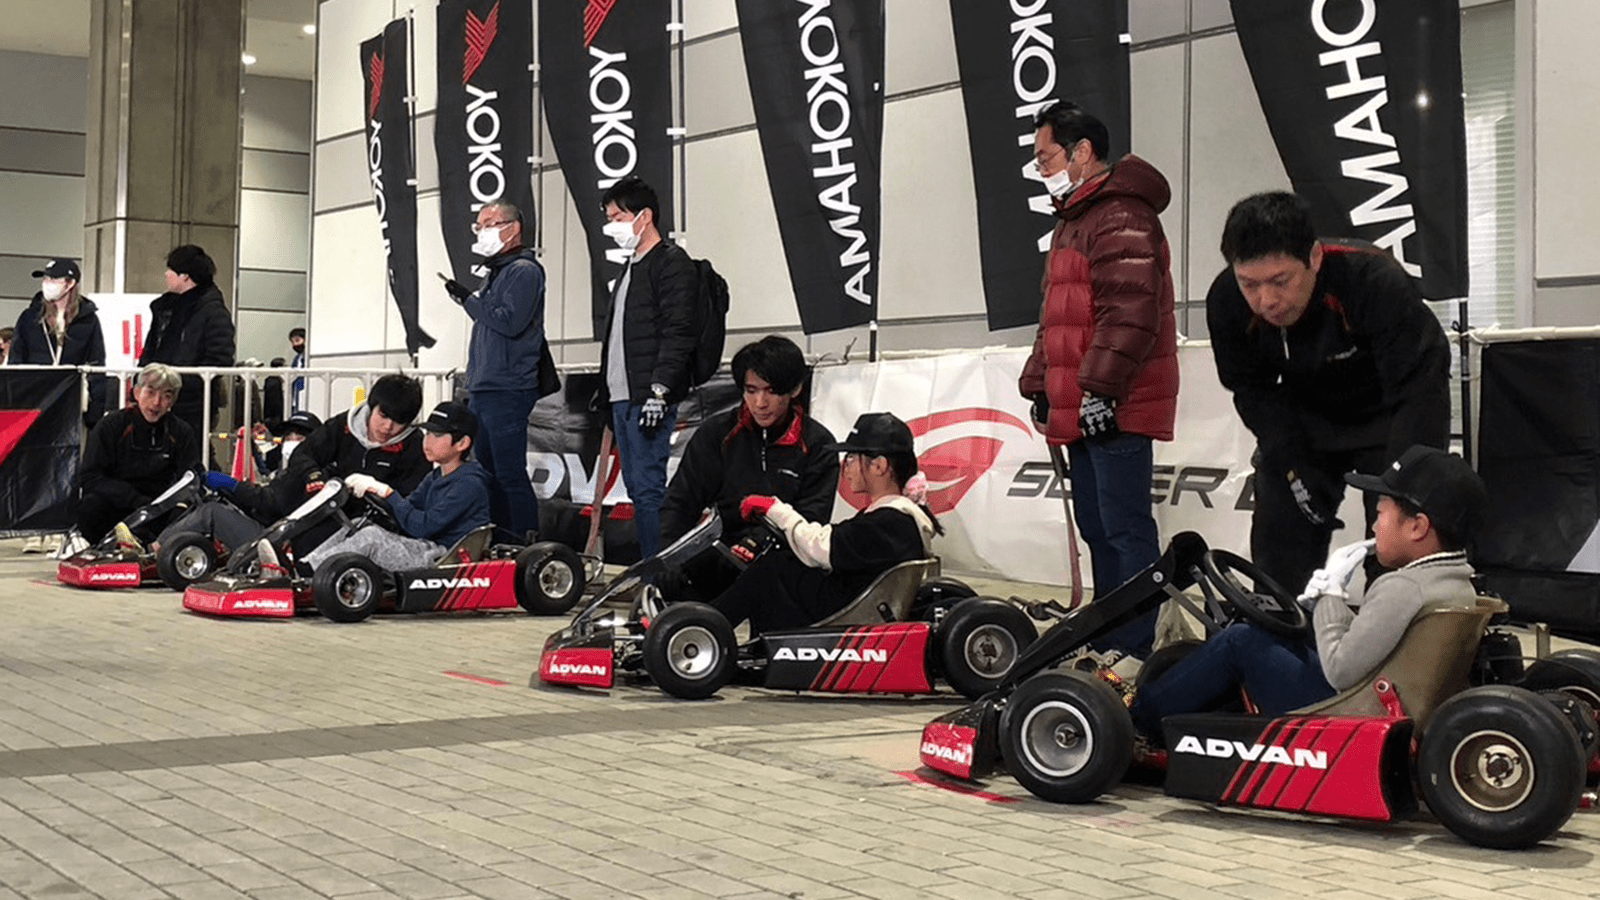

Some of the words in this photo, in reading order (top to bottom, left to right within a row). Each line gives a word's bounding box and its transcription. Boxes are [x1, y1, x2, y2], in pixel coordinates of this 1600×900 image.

[91, 573, 137, 581] ADVAN
[409, 577, 491, 590] ADVAN
[233, 600, 289, 609] ADVAN
[773, 647, 887, 662] ADVAN
[550, 664, 607, 676] ADVAN
[921, 741, 967, 764] ADVAN
[1174, 735, 1327, 769] ADVAN
